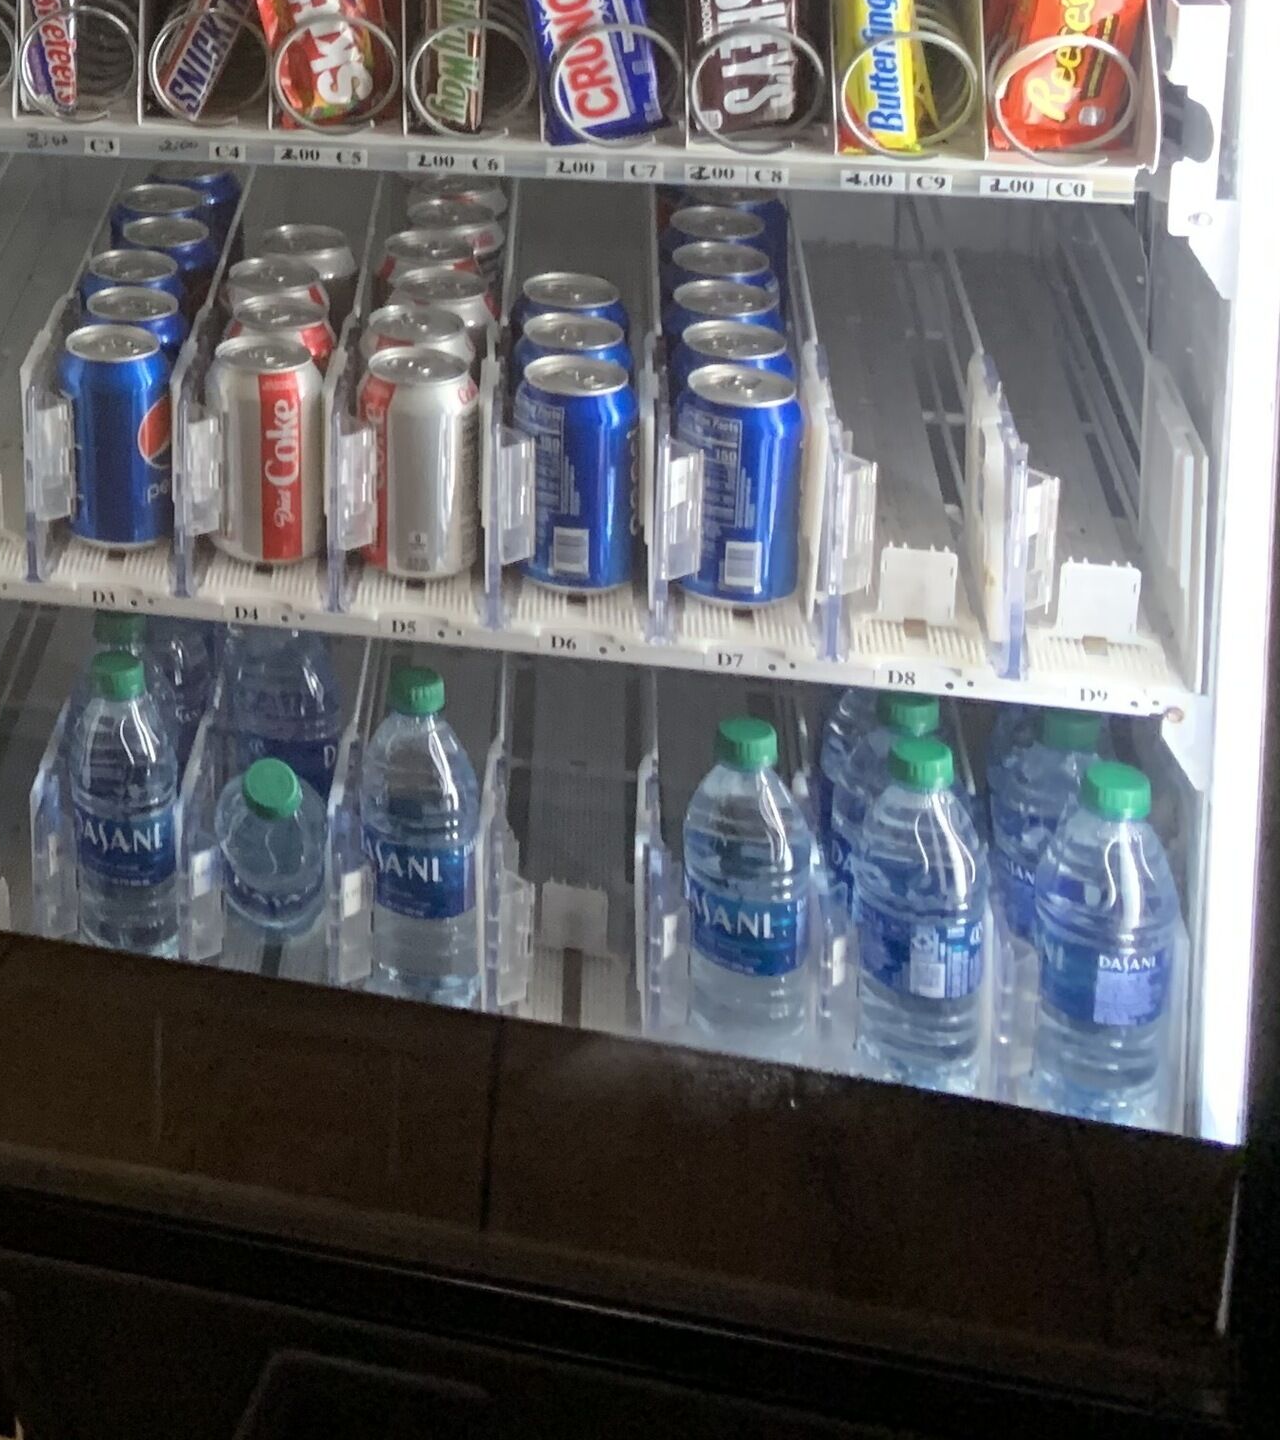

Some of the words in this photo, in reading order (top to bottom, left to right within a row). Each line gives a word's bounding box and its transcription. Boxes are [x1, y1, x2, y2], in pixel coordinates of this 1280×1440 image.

[916, 174, 946, 191] C9
[264, 398, 300, 487] Coke
[91, 589, 116, 604] D3
[233, 606, 259, 622] D4
[391, 619, 417, 635] D5
[549, 633, 578, 651] D6
[716, 652, 745, 668] D7
[886, 668, 917, 687] D8
[1077, 687, 1109, 702] D9
[361, 828, 442, 884] SANI
[685, 878, 775, 940] SANI
[1098, 953, 1156, 973] DASANI
